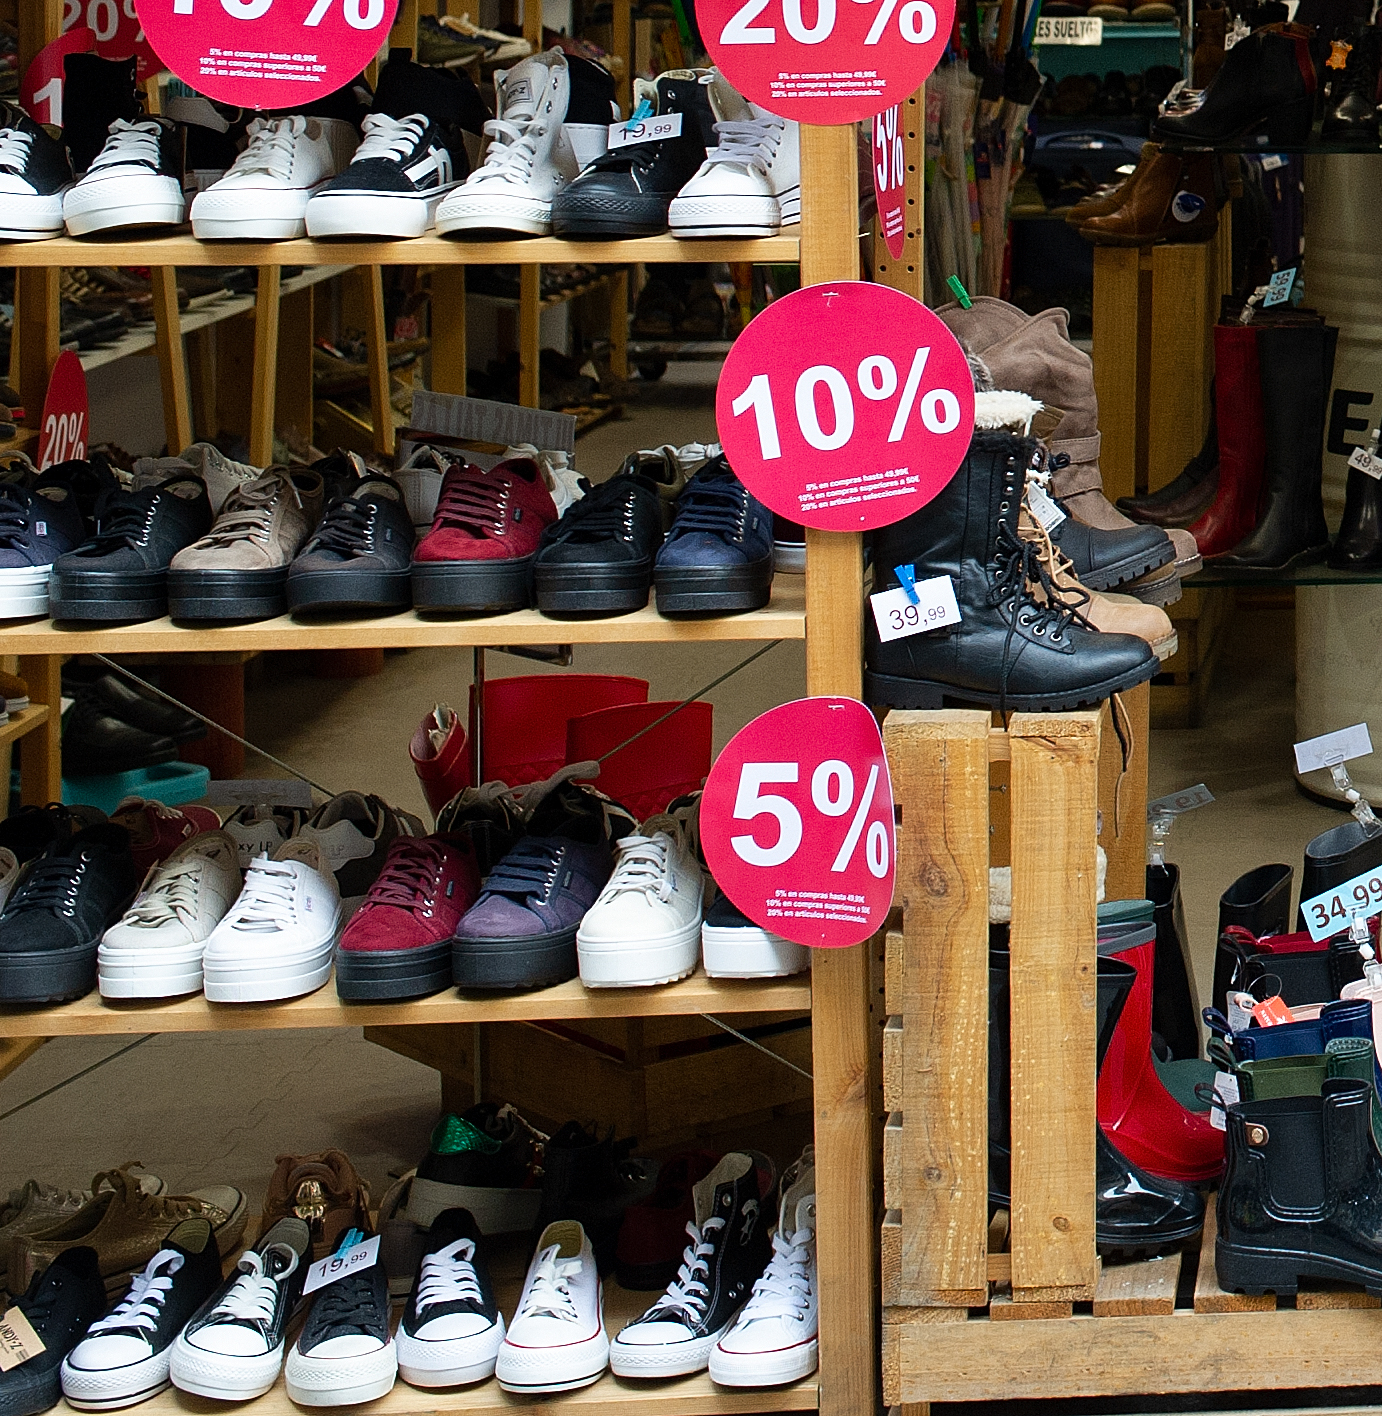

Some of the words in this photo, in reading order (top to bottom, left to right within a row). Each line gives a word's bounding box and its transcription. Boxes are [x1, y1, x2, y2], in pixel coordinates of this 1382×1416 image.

[619, 124, 671, 141] 19,99
[732, 347, 960, 460] 10%
[1354, 453, 1382, 473] 49,99
[889, 605, 946, 631] 39,99
[731, 754, 892, 878] 5%
[319, 1251, 368, 1276] 19,99
